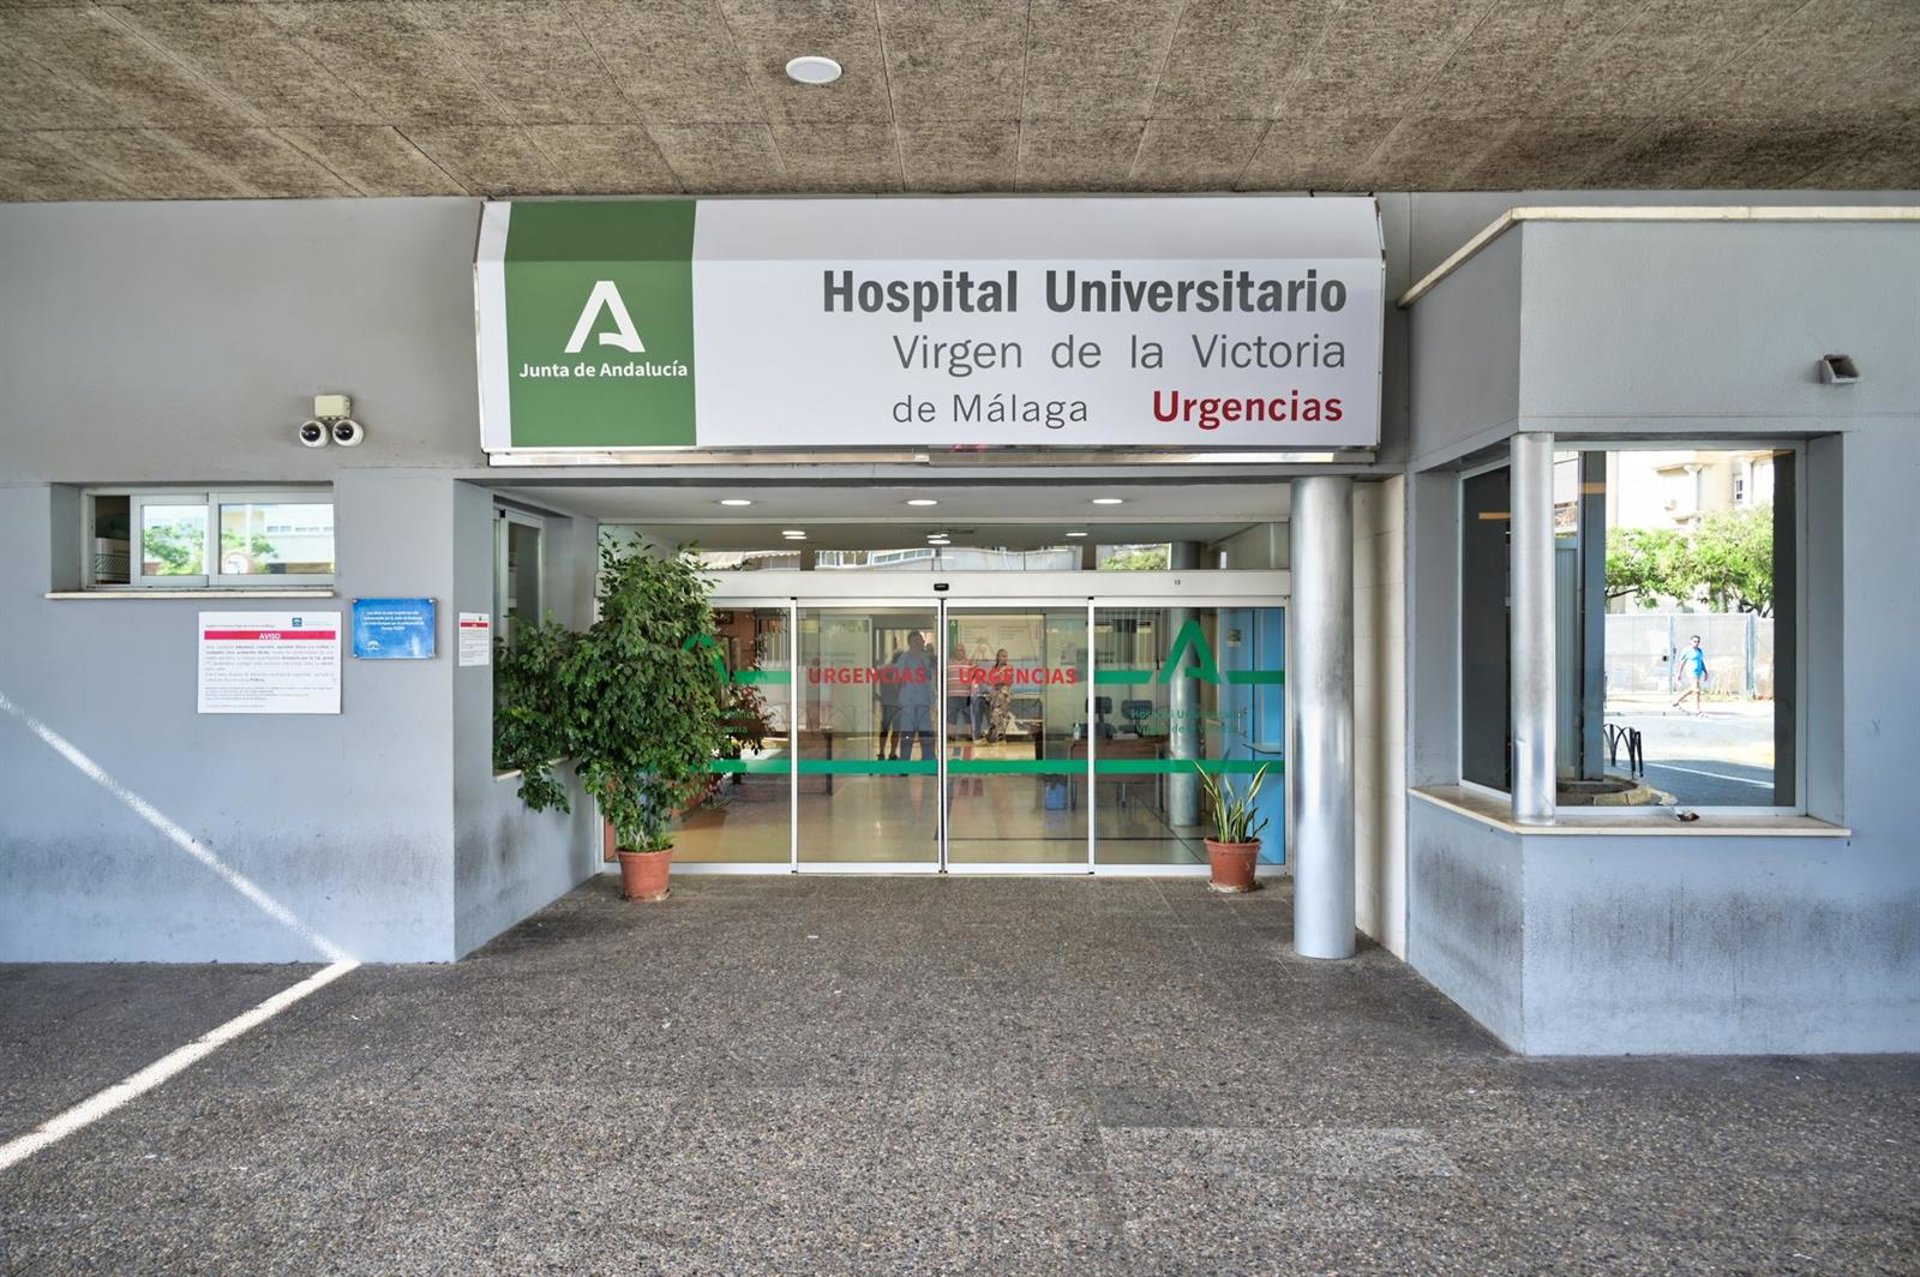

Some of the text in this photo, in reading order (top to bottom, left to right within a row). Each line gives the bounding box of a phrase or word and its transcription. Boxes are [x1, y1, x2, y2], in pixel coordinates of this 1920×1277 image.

[823, 269, 1347, 322] Hospital Universitario
[519, 359, 688, 378] Junta de Andalucía
[892, 332, 1346, 378] Virgen de la Victoria
[892, 388, 1344, 430] de Málaga Urgencias
[808, 667, 927, 685] URGENCIAS
[959, 666, 1078, 685] URGENCIAS
